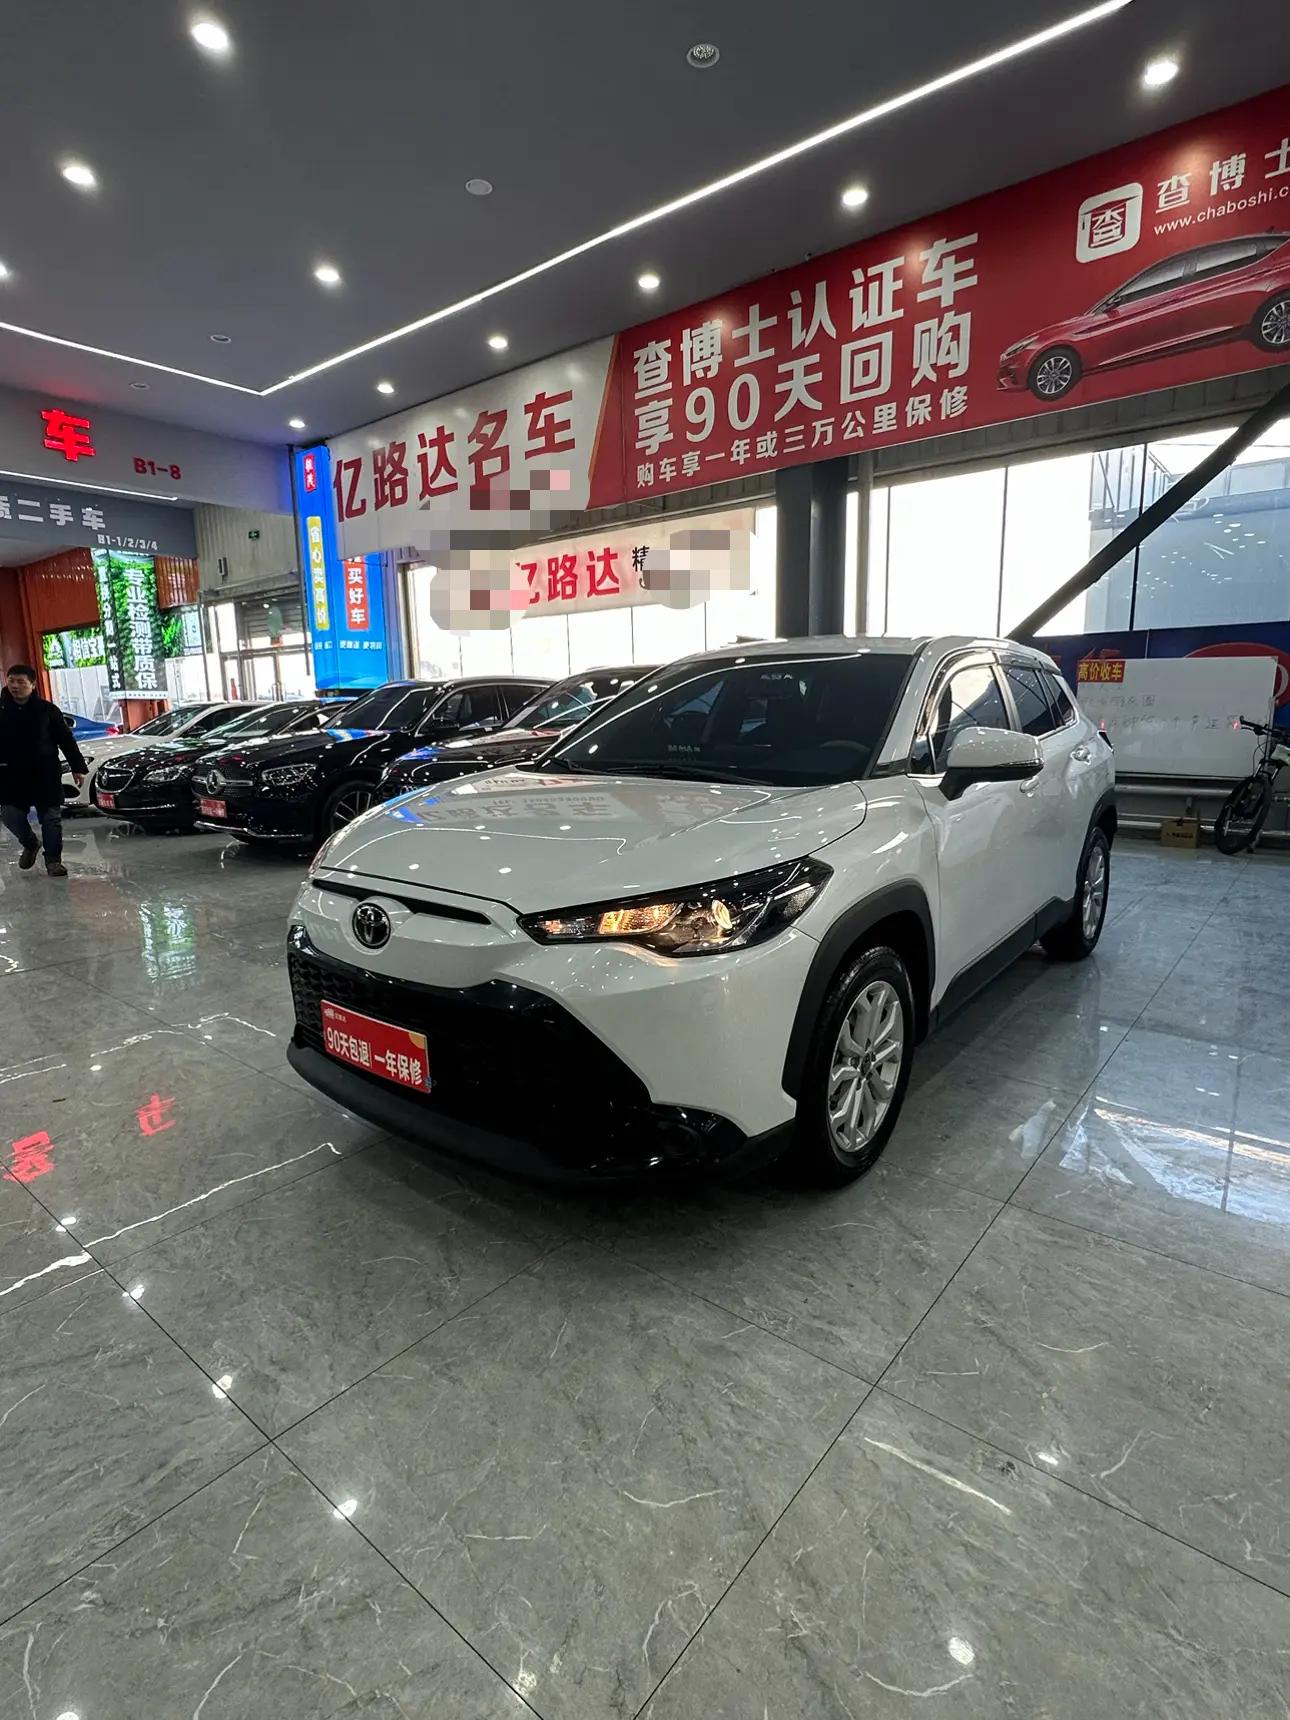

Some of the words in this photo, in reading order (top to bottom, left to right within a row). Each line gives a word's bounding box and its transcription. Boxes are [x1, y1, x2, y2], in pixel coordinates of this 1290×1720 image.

[1154, 135, 1290, 215] 查博士
[1154, 186, 1289, 236] www.chaboshi.c
[633, 232, 978, 400] 查博士认证车
[634, 310, 972, 456] 享90天回购
[41, 409, 96, 463] 车
[333, 389, 576, 523] 亿路达名车
[636, 385, 968, 489] 购车享一年或三万公里保修
[133, 457, 182, 480] B1-8
[97, 533, 158, 550] B1-1/2/3/4
[1077, 663, 1123, 681] 高价收车
[374, 1049, 422, 1085] 一年保修
